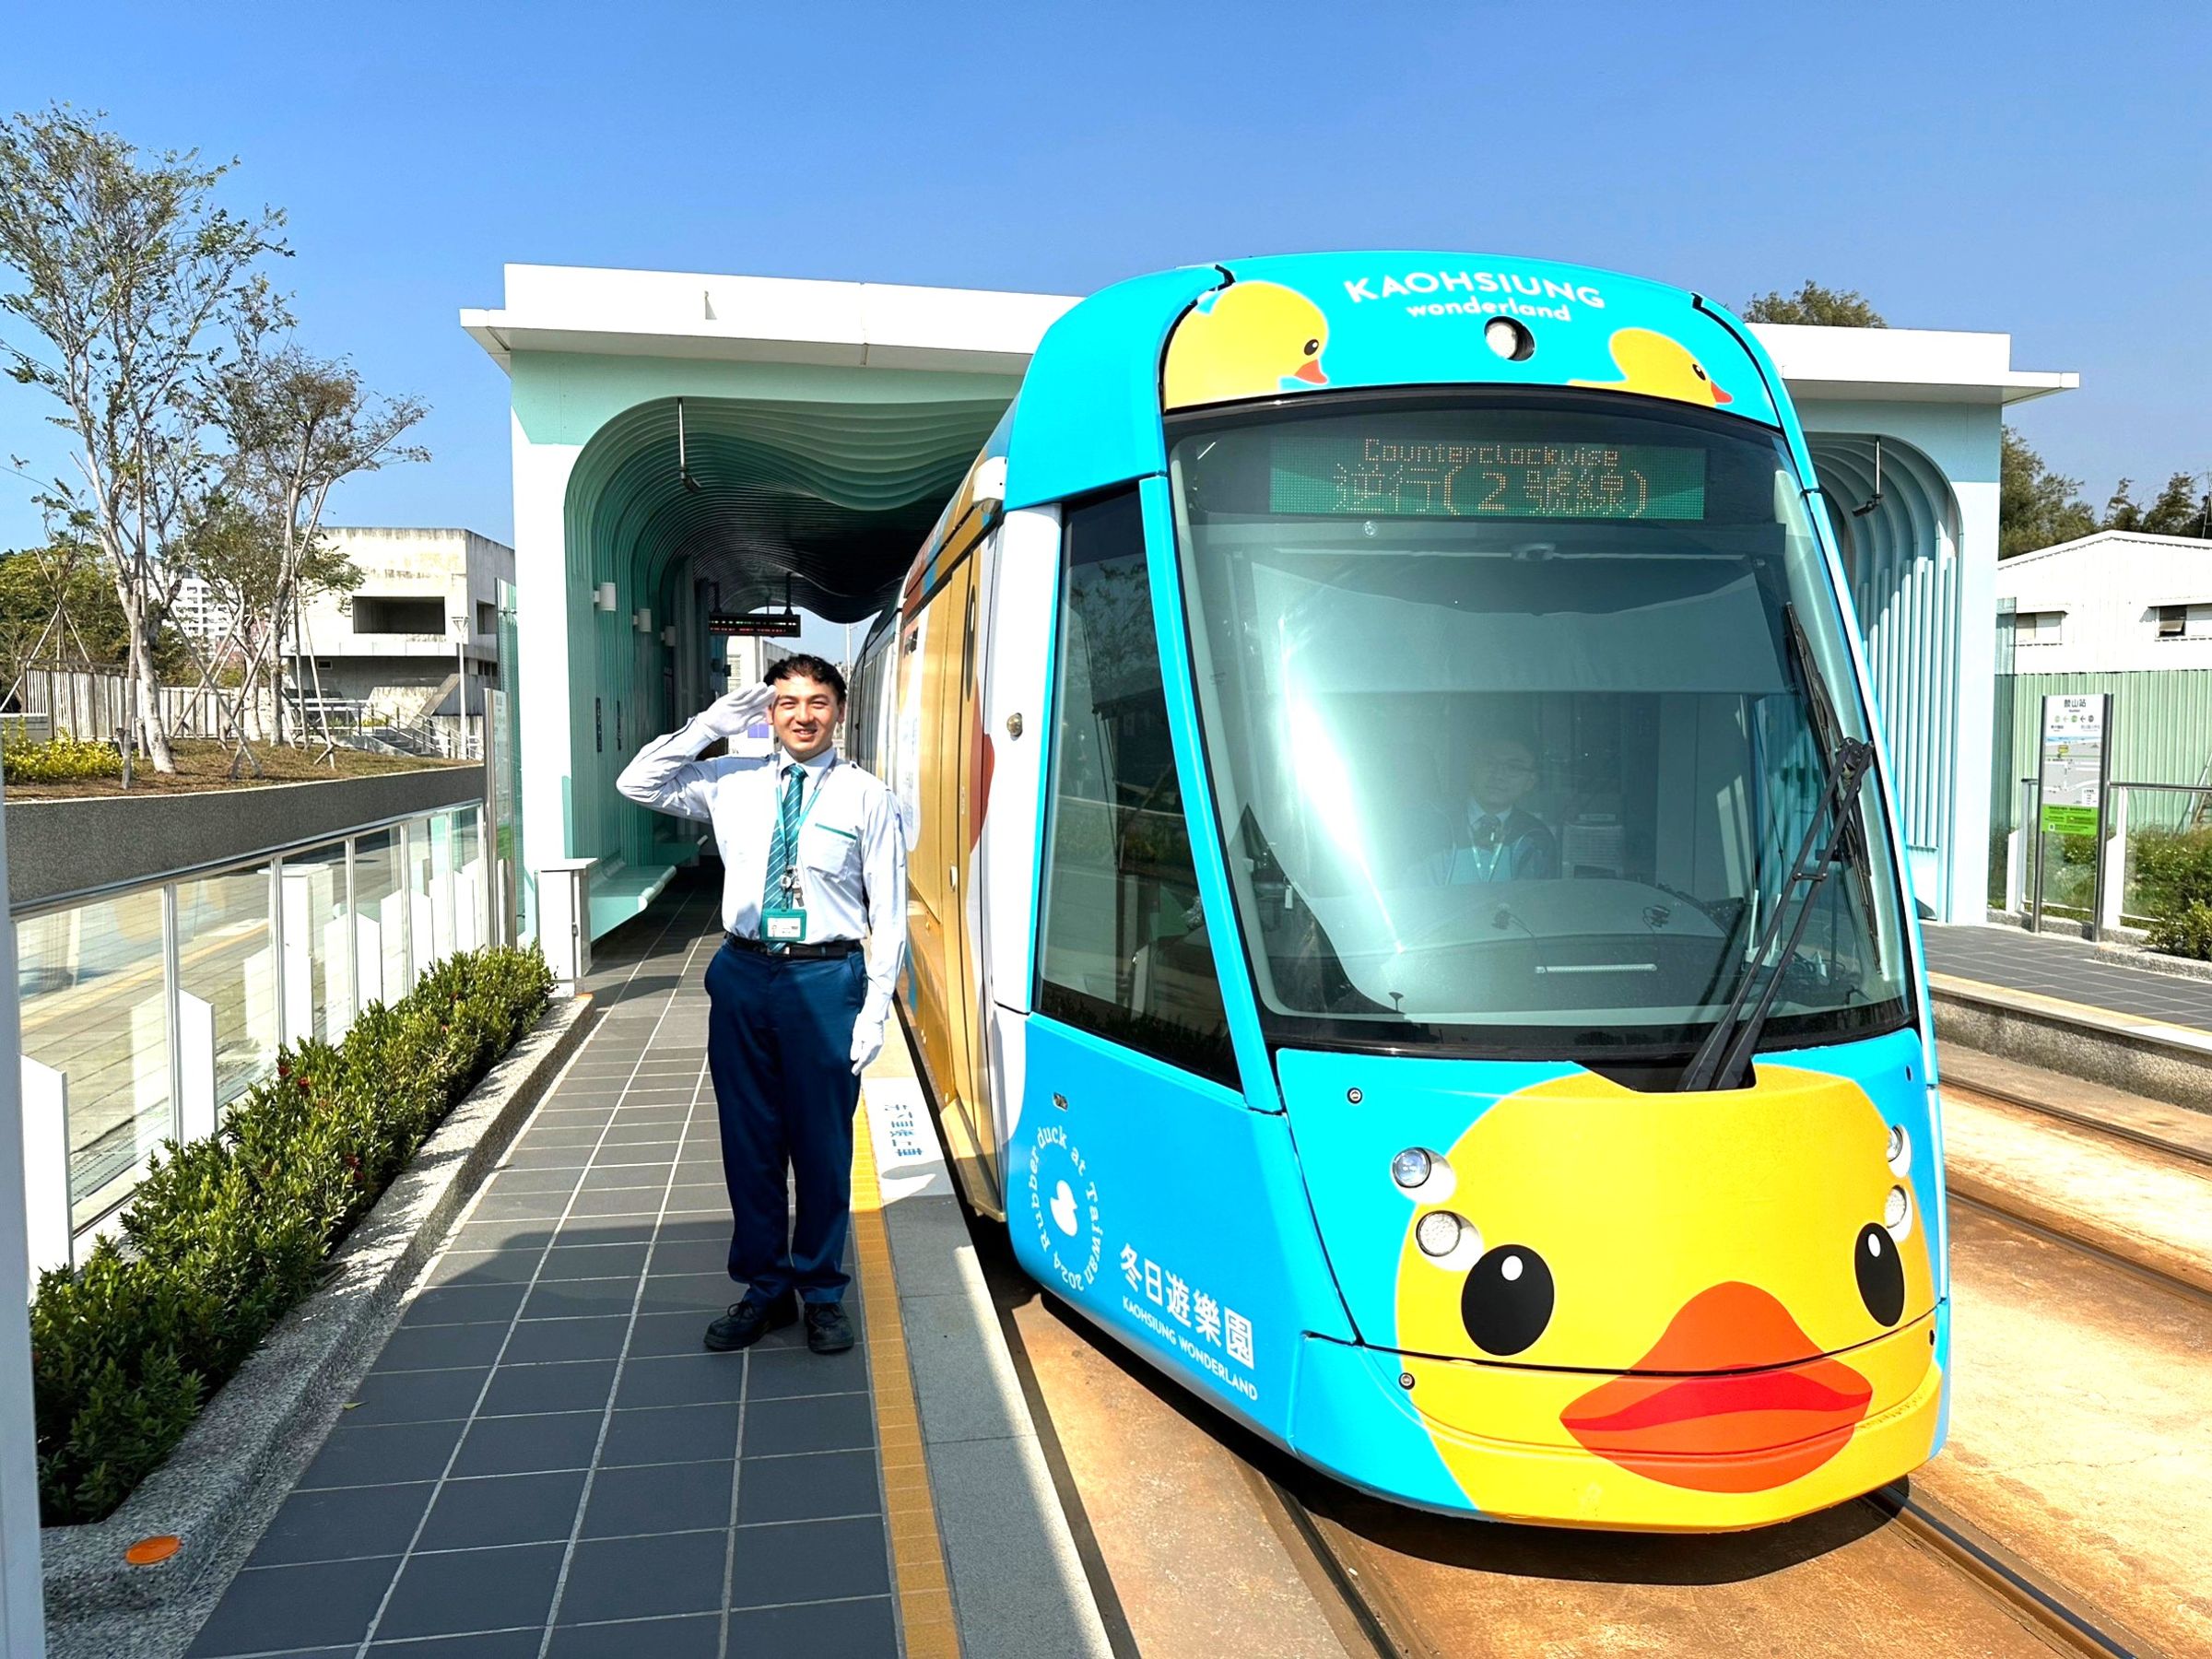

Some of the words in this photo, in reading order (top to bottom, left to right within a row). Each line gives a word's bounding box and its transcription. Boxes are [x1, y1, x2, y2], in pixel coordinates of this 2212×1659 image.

[1344, 271, 1606, 309] KAOHSIUNG
[1406, 296, 1571, 322] wonderland
[1365, 439, 1619, 466] Counterclockwise
[1037, 1125, 1067, 1149] duck
[1071, 1147, 1086, 1176] at
[1029, 1146, 1051, 1253] Rubber
[1085, 1182, 1103, 1285] Taiwan
[1053, 1251, 1085, 1292] 2024
[1120, 1242, 1254, 1371] 冬日遊樂園
[1122, 1295, 1176, 1346] KAOHSIUNG
[1178, 1335, 1258, 1401] WONDERLAND
